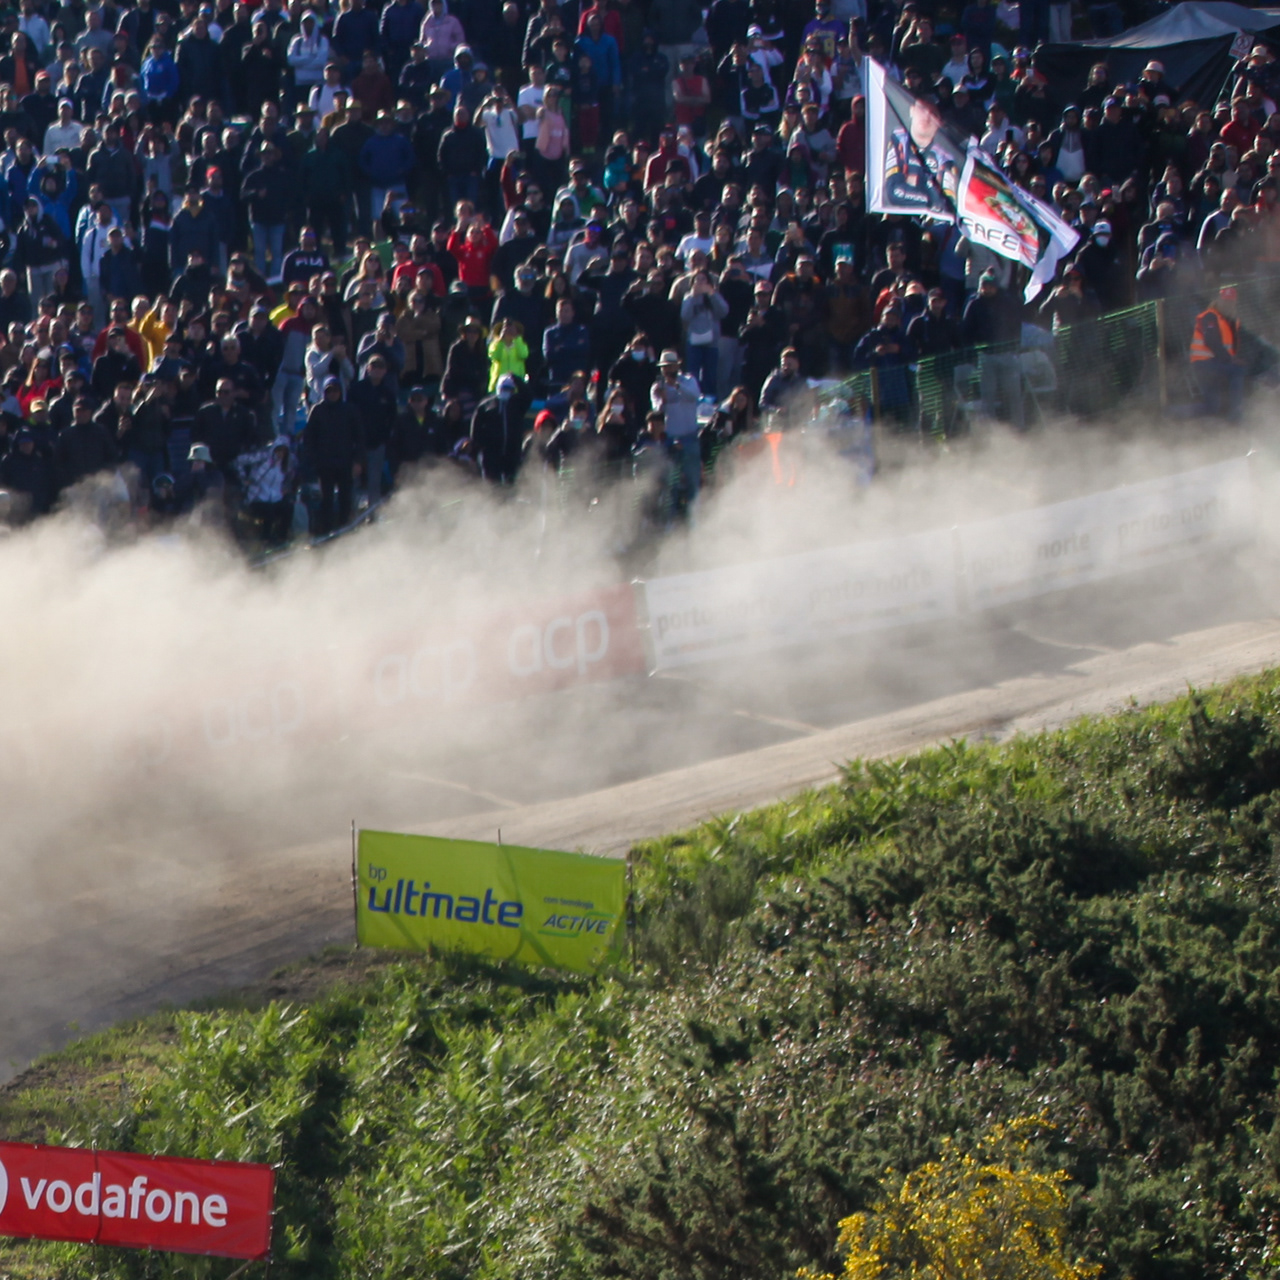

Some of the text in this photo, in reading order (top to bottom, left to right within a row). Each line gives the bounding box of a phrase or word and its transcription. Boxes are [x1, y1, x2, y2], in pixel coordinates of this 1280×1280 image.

[1037, 530, 1092, 560] norte
[508, 610, 609, 675] acp
[375, 640, 475, 706] acp
[368, 863, 387, 883] bp
[367, 877, 523, 928] ultimate
[543, 913, 609, 935] ACTIVE
[20, 1172, 228, 1227] vodafone
